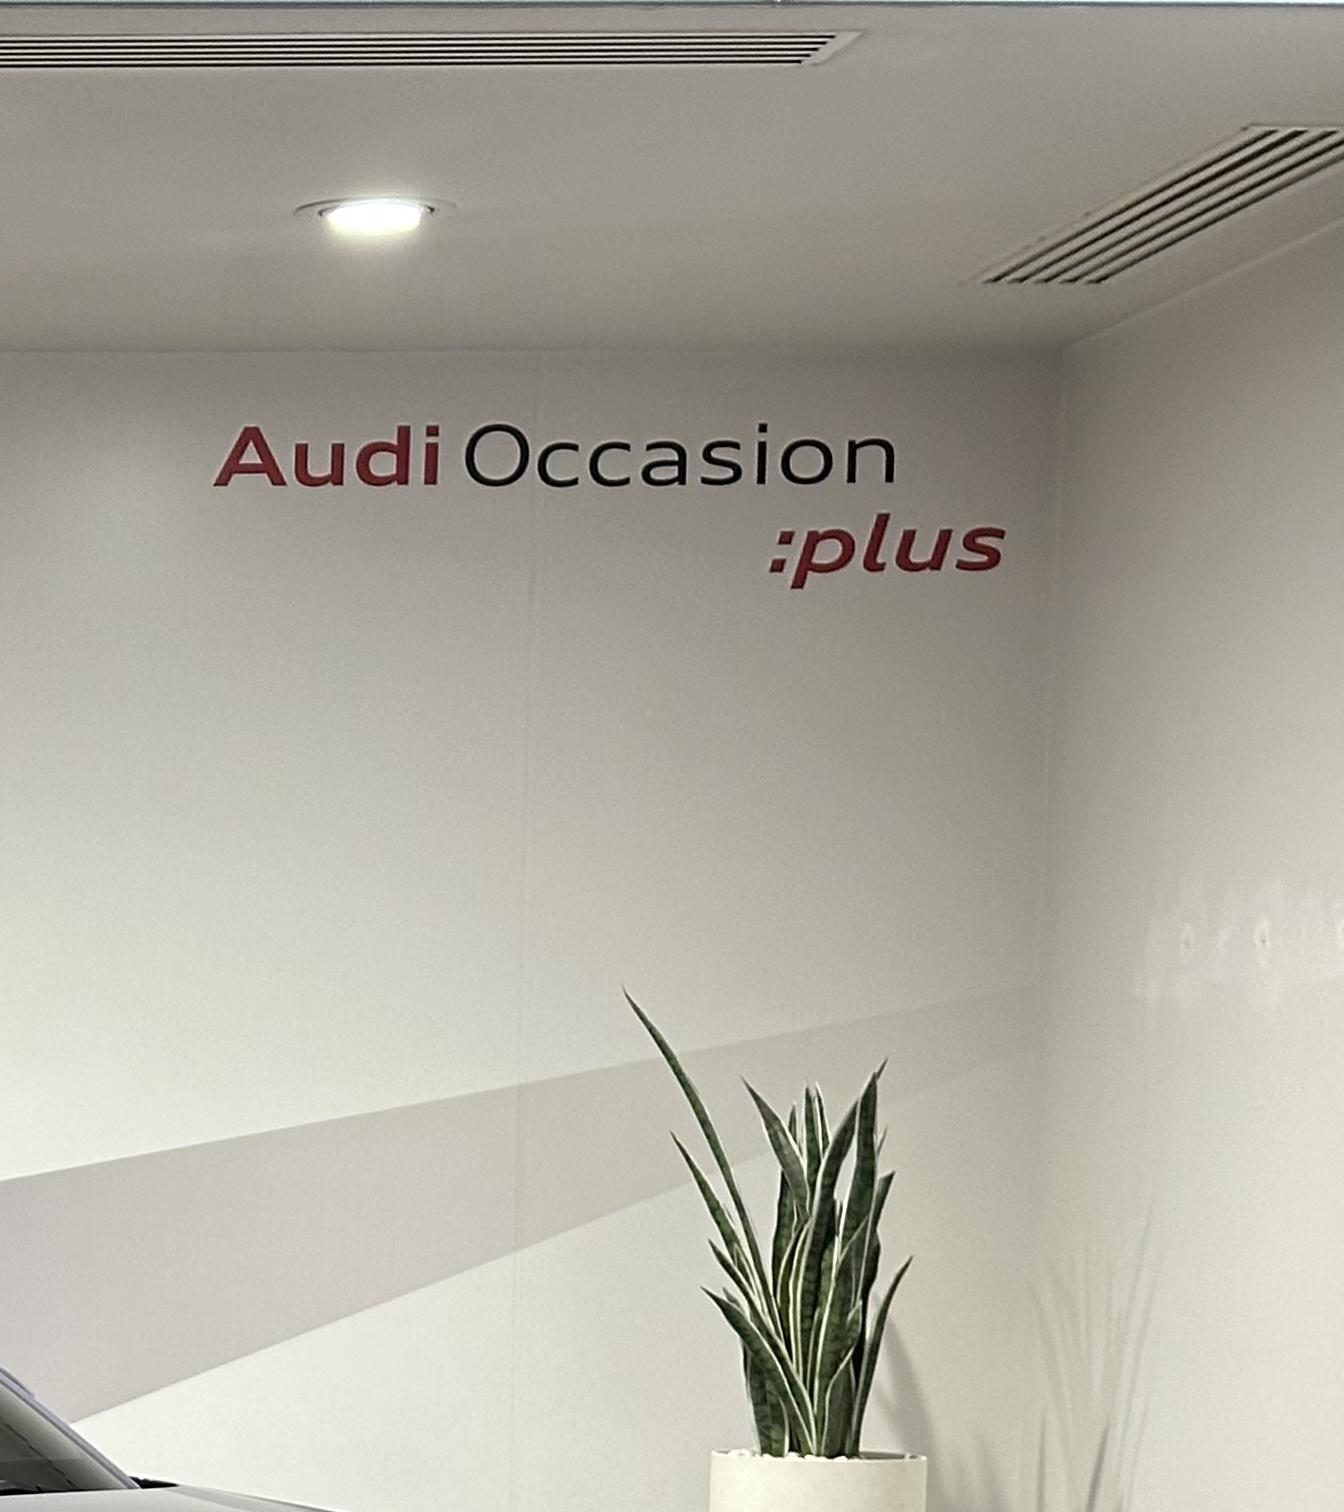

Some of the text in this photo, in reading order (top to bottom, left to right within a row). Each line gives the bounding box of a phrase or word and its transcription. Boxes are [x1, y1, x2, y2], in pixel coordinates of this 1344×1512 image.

[212, 421, 896, 489] Audi Occasion
[768, 512, 1007, 590] :plus
